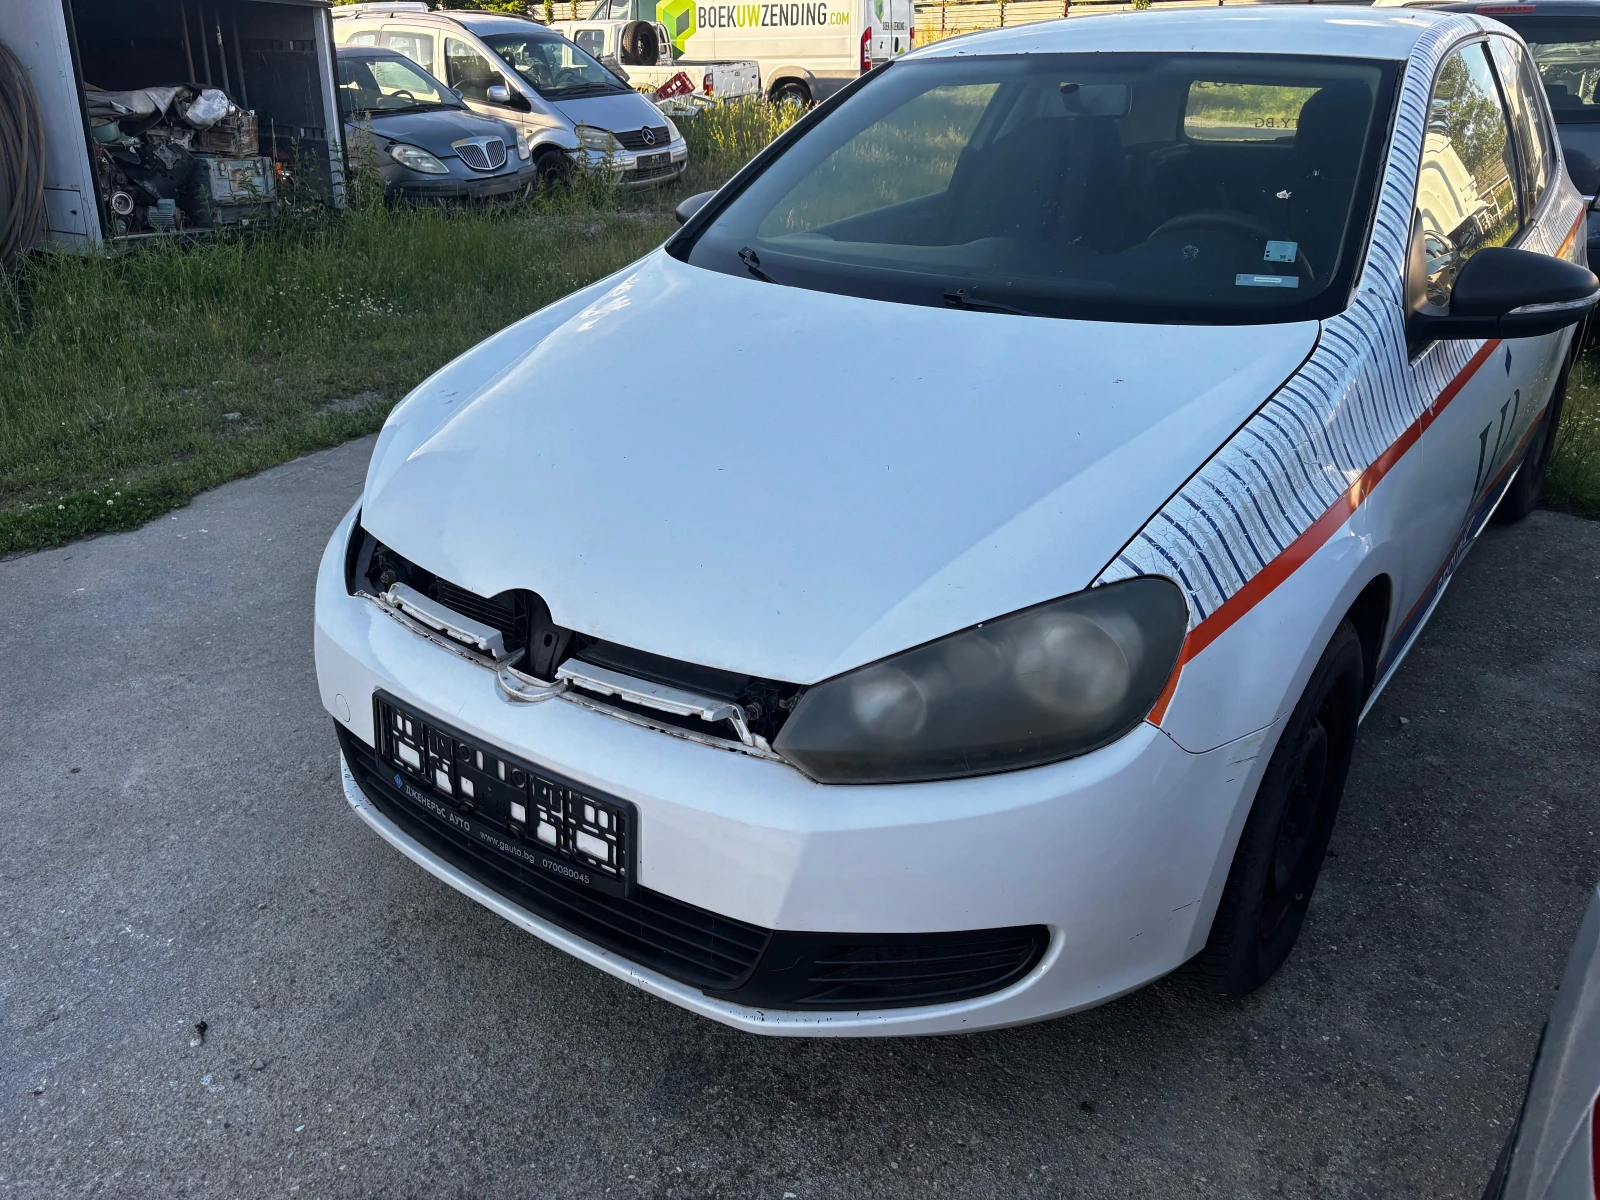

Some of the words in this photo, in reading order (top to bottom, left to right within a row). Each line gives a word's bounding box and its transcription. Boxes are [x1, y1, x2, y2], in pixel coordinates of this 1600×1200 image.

[405, 785, 446, 818] ДЖЕНЕРЪС
[449, 813, 471, 832] АУТО
[479, 831, 535, 864] www.gauto.bg
[542, 858, 590, 884] 070080045
